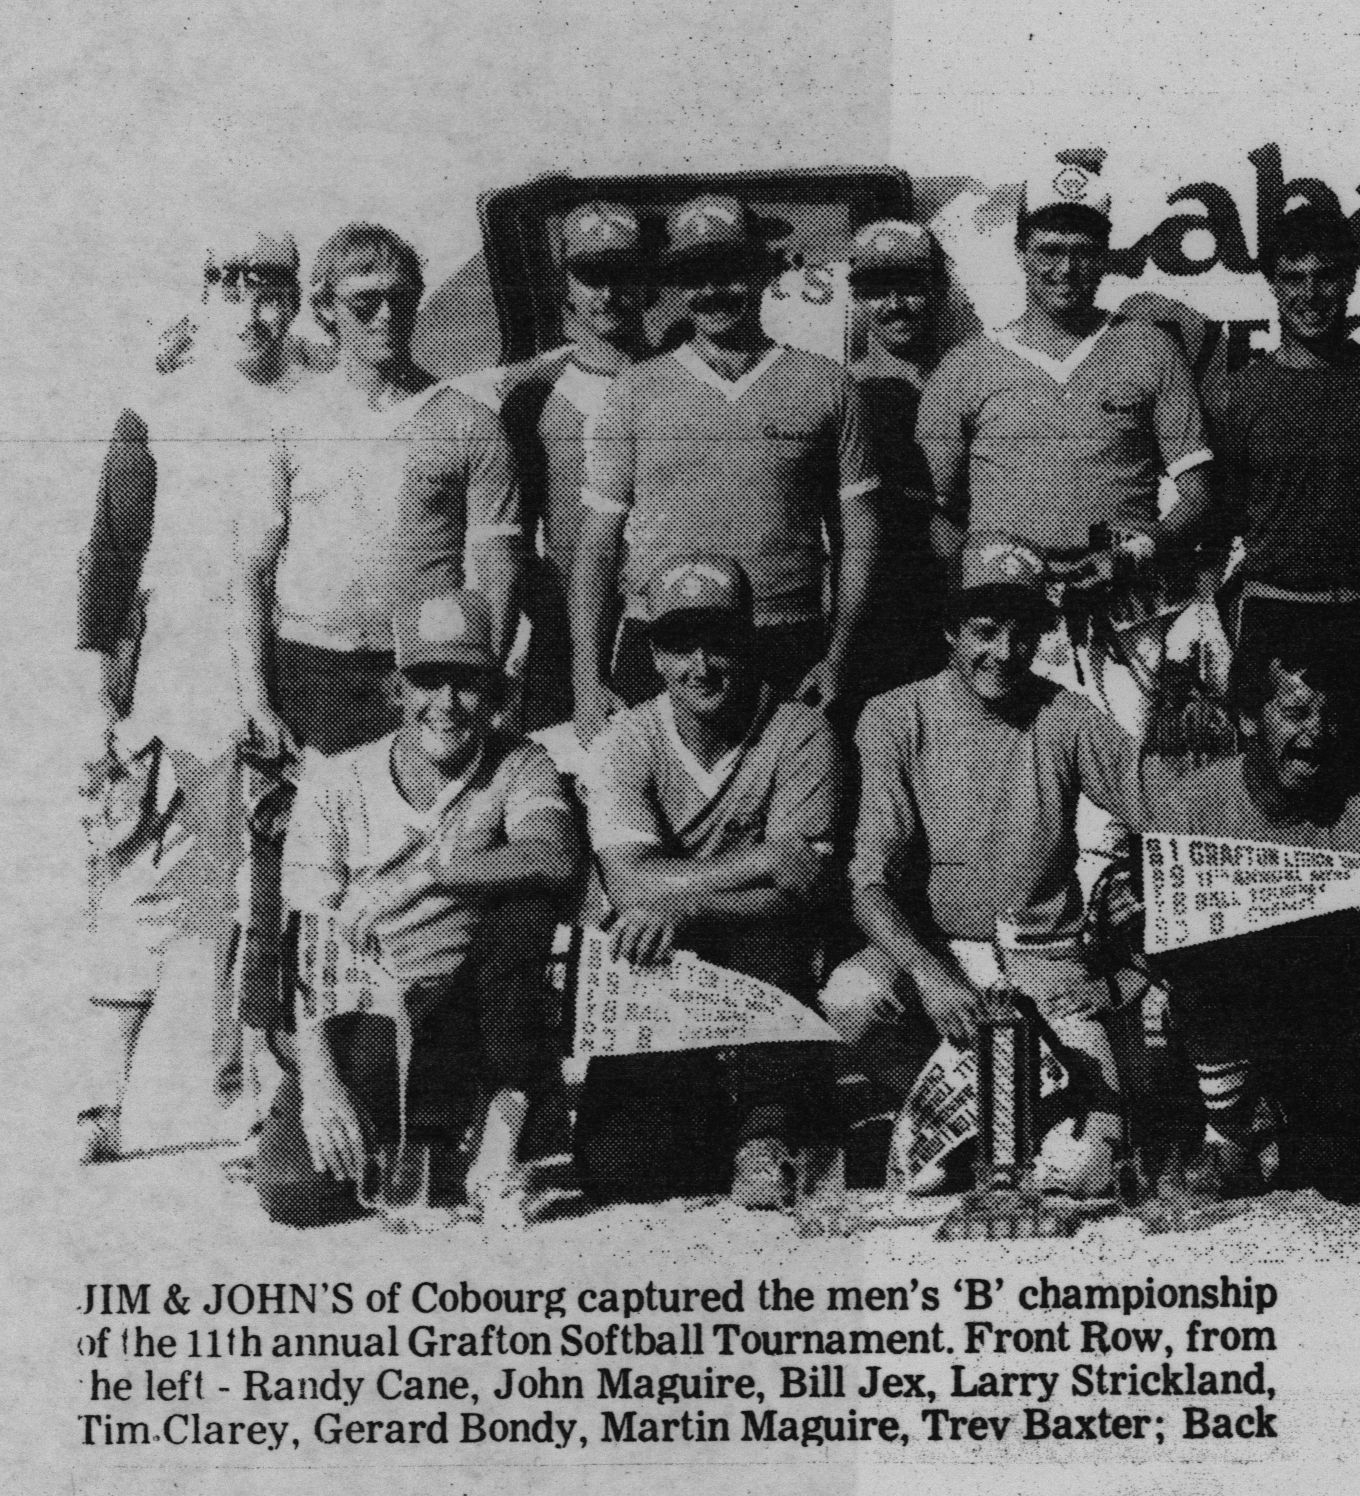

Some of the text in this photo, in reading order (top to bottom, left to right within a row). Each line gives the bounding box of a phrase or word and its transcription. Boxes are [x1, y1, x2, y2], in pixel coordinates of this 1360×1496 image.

[77, 1274, 1278, 1320] JIM & JOHN'S of Cobourg captured the men's 'B' championship
[77, 1326, 112, 1359] of
[187, 1325, 263, 1358] 11th
[271, 1324, 400, 1358] annual
[408, 1323, 553, 1358] Grafton
[560, 1322, 705, 1357] Softball
[712, 1322, 954, 1357] Tournament.
[964, 1320, 1071, 1354] Front
[1080, 1320, 1174, 1359] Row,
[1185, 1319, 1278, 1353] from
[79, 1368, 133, 1402] he
[145, 1369, 204, 1402] left
[242, 1368, 365, 1406] Randy
[376, 1368, 479, 1406] Cane,
[493, 1366, 585, 1400] John
[596, 1366, 765, 1406] Maguire,
[779, 1364, 846, 1399] Bill
[857, 1365, 937, 1404] Jex,
[950, 1364, 1060, 1403] Larry
[1071, 1360, 1276, 1401] Strickland,
[78, 1404, 1278, 1450] Tim Clarey, Gerard Bondy, Martin Maguire, Trev Baxter; Back
